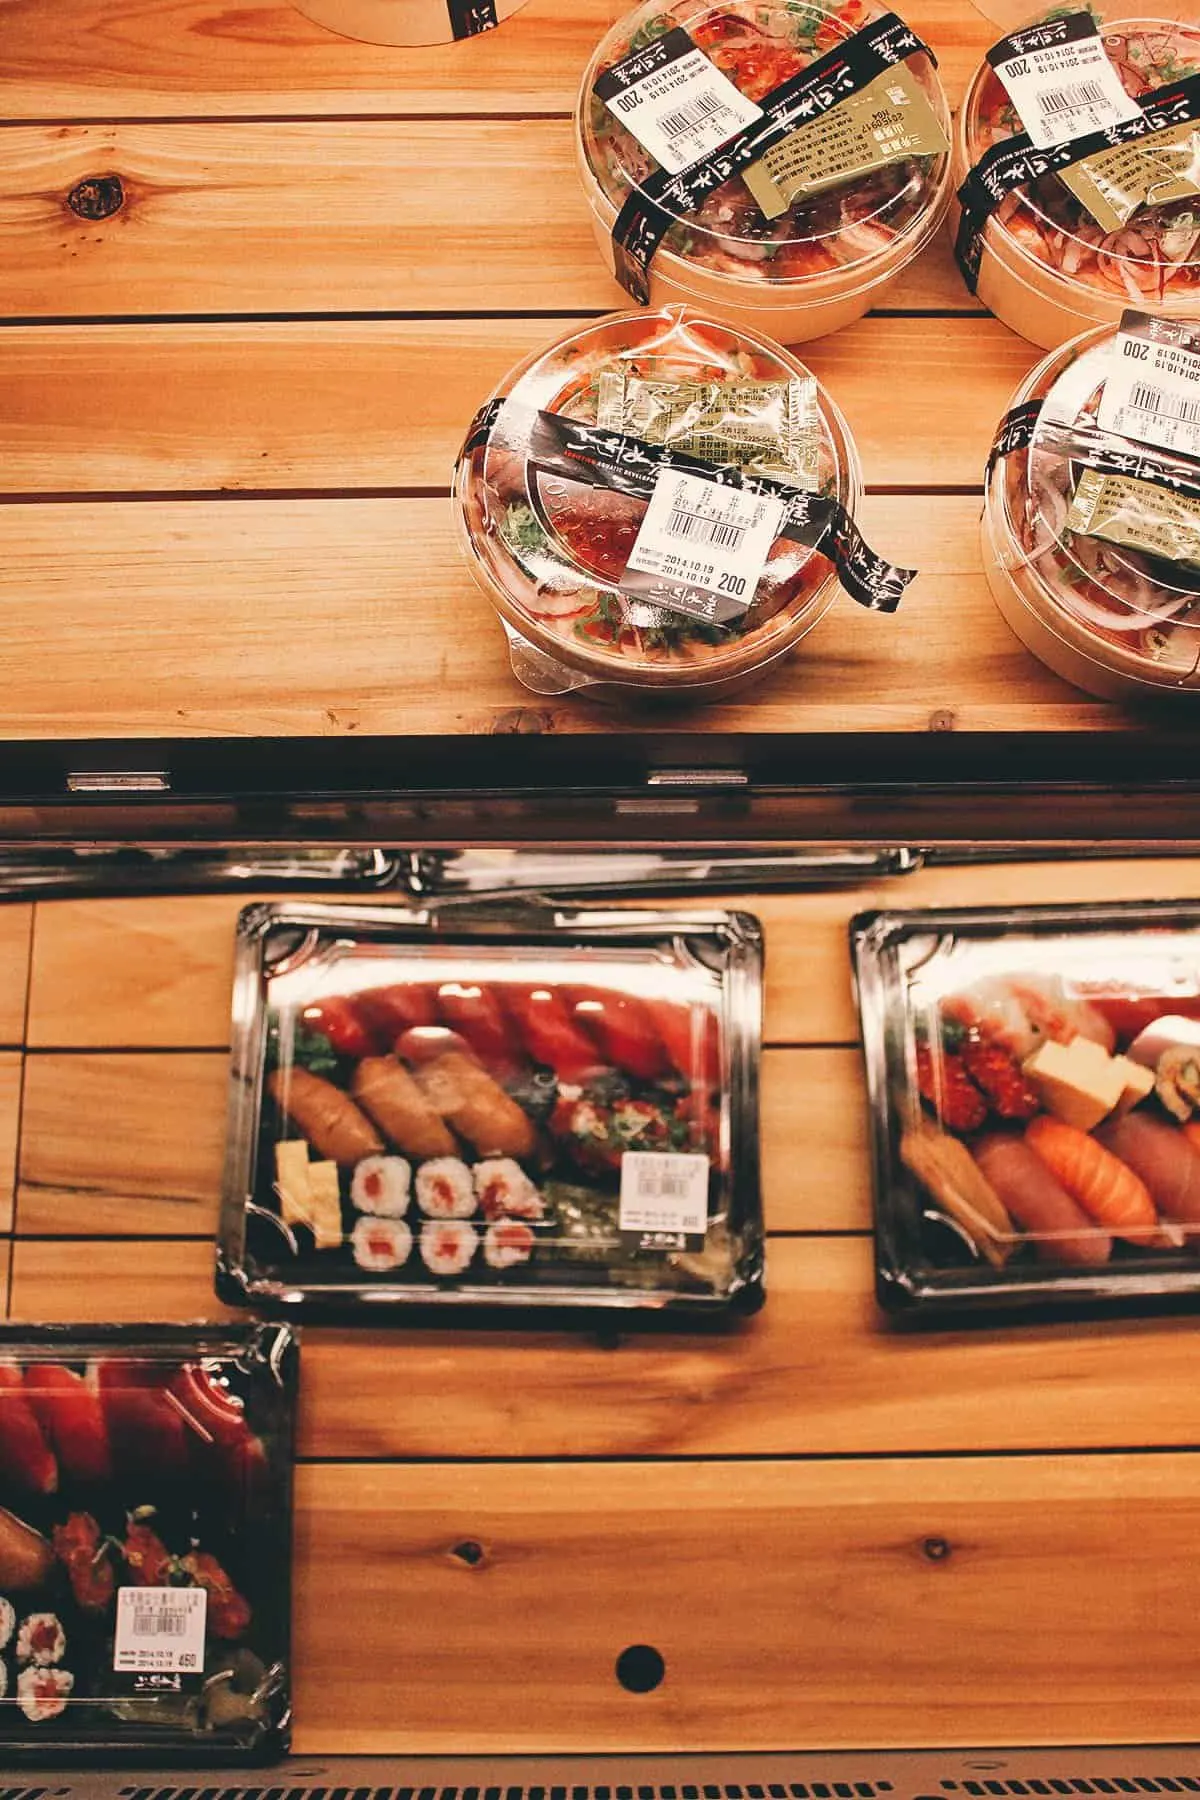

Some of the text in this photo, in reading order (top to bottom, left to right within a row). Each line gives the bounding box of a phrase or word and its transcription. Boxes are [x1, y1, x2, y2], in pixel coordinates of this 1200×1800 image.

[1005, 59, 1031, 79] 200
[616, 90, 644, 113] 200
[1123, 340, 1150, 361] 200
[664, 555, 714, 574] 2014.10.19
[661, 565, 711, 586] 2014.10.19
[718, 573, 746, 596] 200
